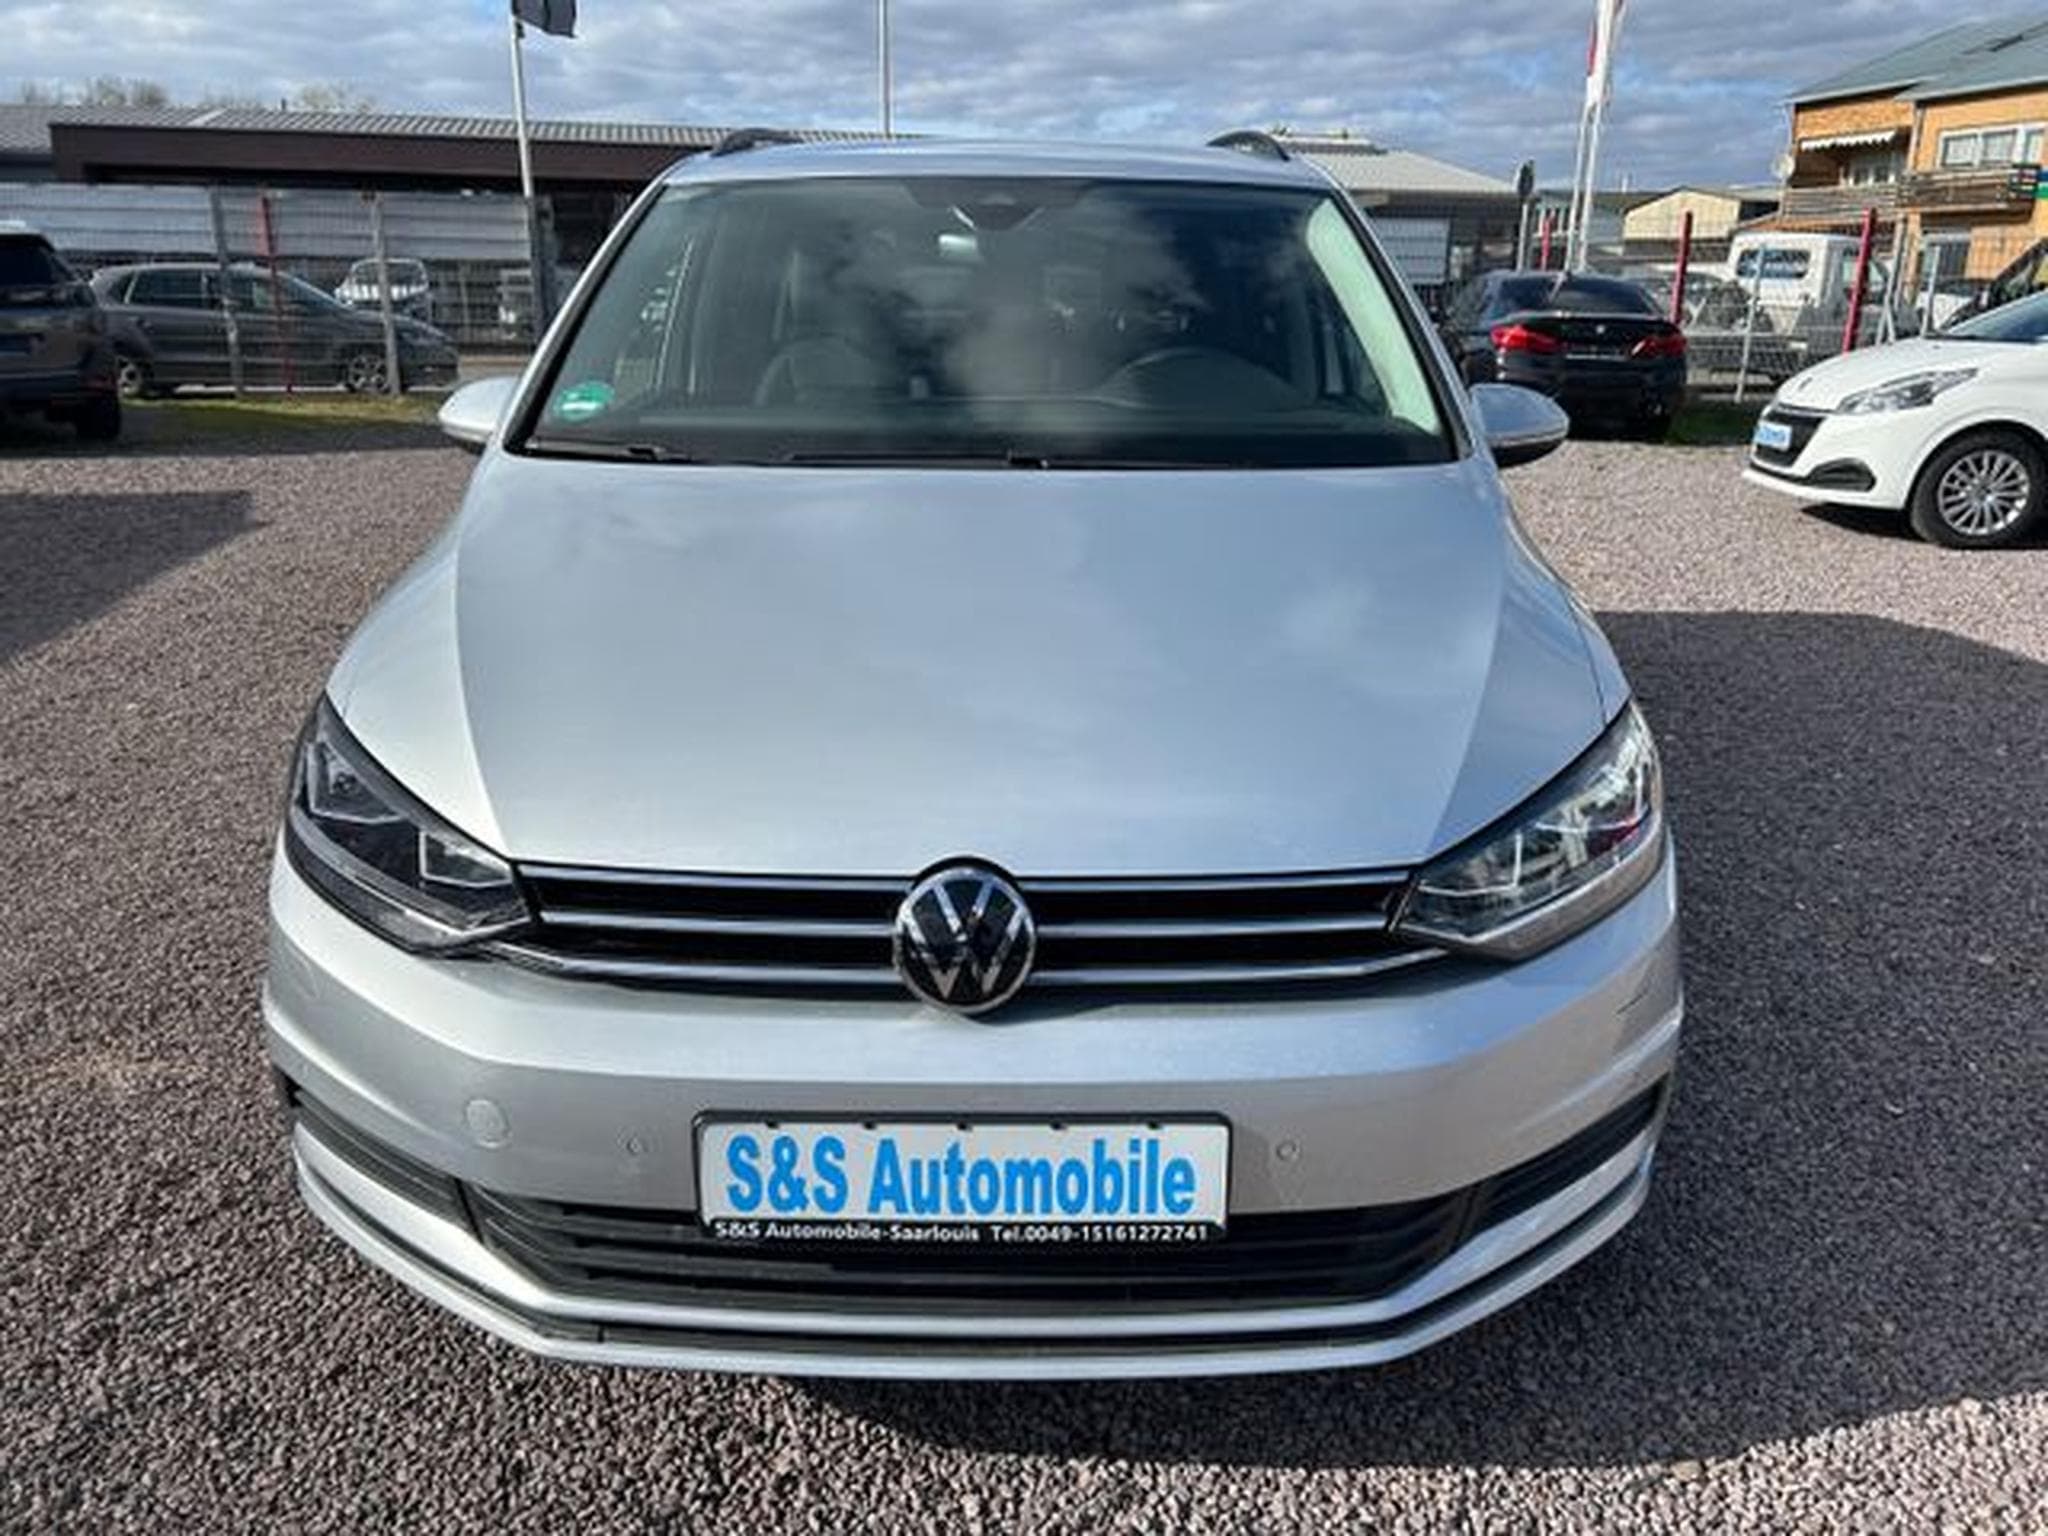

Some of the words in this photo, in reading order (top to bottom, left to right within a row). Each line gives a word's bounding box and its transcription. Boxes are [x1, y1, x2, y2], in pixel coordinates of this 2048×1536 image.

[726, 1133, 849, 1214] S&S
[866, 1136, 1197, 1216] Automobile
[715, 1221, 760, 1239] S&S
